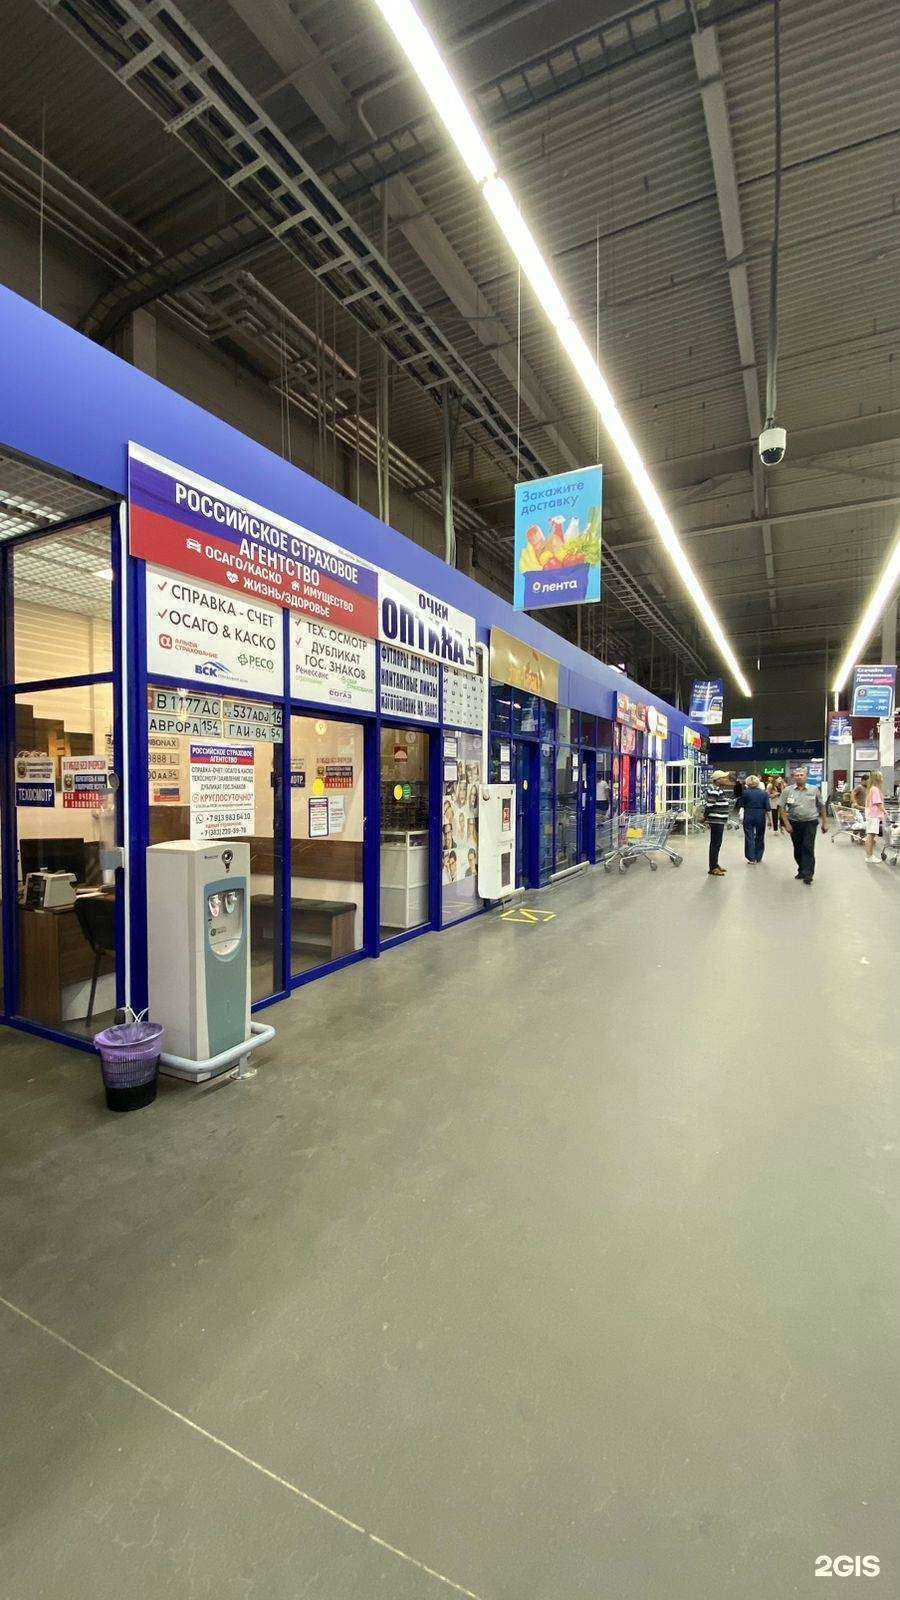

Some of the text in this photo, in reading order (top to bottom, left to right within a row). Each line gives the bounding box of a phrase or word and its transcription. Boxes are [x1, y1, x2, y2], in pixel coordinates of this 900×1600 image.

[522, 482, 585, 502] Закажите
[521, 495, 579, 516] доставку
[175, 482, 359, 585] РОССИЙСКОЕ СТРАХОВОЕ
[205, 546, 283, 585] ОСАГО/КАСКО
[239, 538, 320, 587] АГЕНТСТВО
[243, 576, 332, 618] ЖИЗНЬ/ЗДОРОВЬЕ
[303, 584, 354, 613] ИМУЩЕСТВО
[542, 579, 579, 593] лента
[171, 584, 237, 617] СПРАВКА
[246, 608, 275, 628] СЧЕТ
[418, 593, 449, 621] ОЧКИ
[169, 610, 276, 651] ОСАГО & КАСКО
[306, 621, 368, 651] ТЕХ. ОСМОТР
[382, 597, 465, 666] ОПТИКА
[248, 654, 274, 671] РЕСО
[311, 641, 361, 665] ДУБЛИКАТ
[195, 664, 218, 678] ВСК
[304, 654, 366, 680] ГОС. ЗНАКОВ
[149, 718, 218, 734] АВРОРА 154
[270, 728, 281, 738] 54
[191, 746, 253, 757] РОССИЙСКОЕ СТРАХОВОЕ
[209, 756, 238, 764] АГЕНТСТВО
[18, 788, 53, 802] ТЕХОСМОТР
